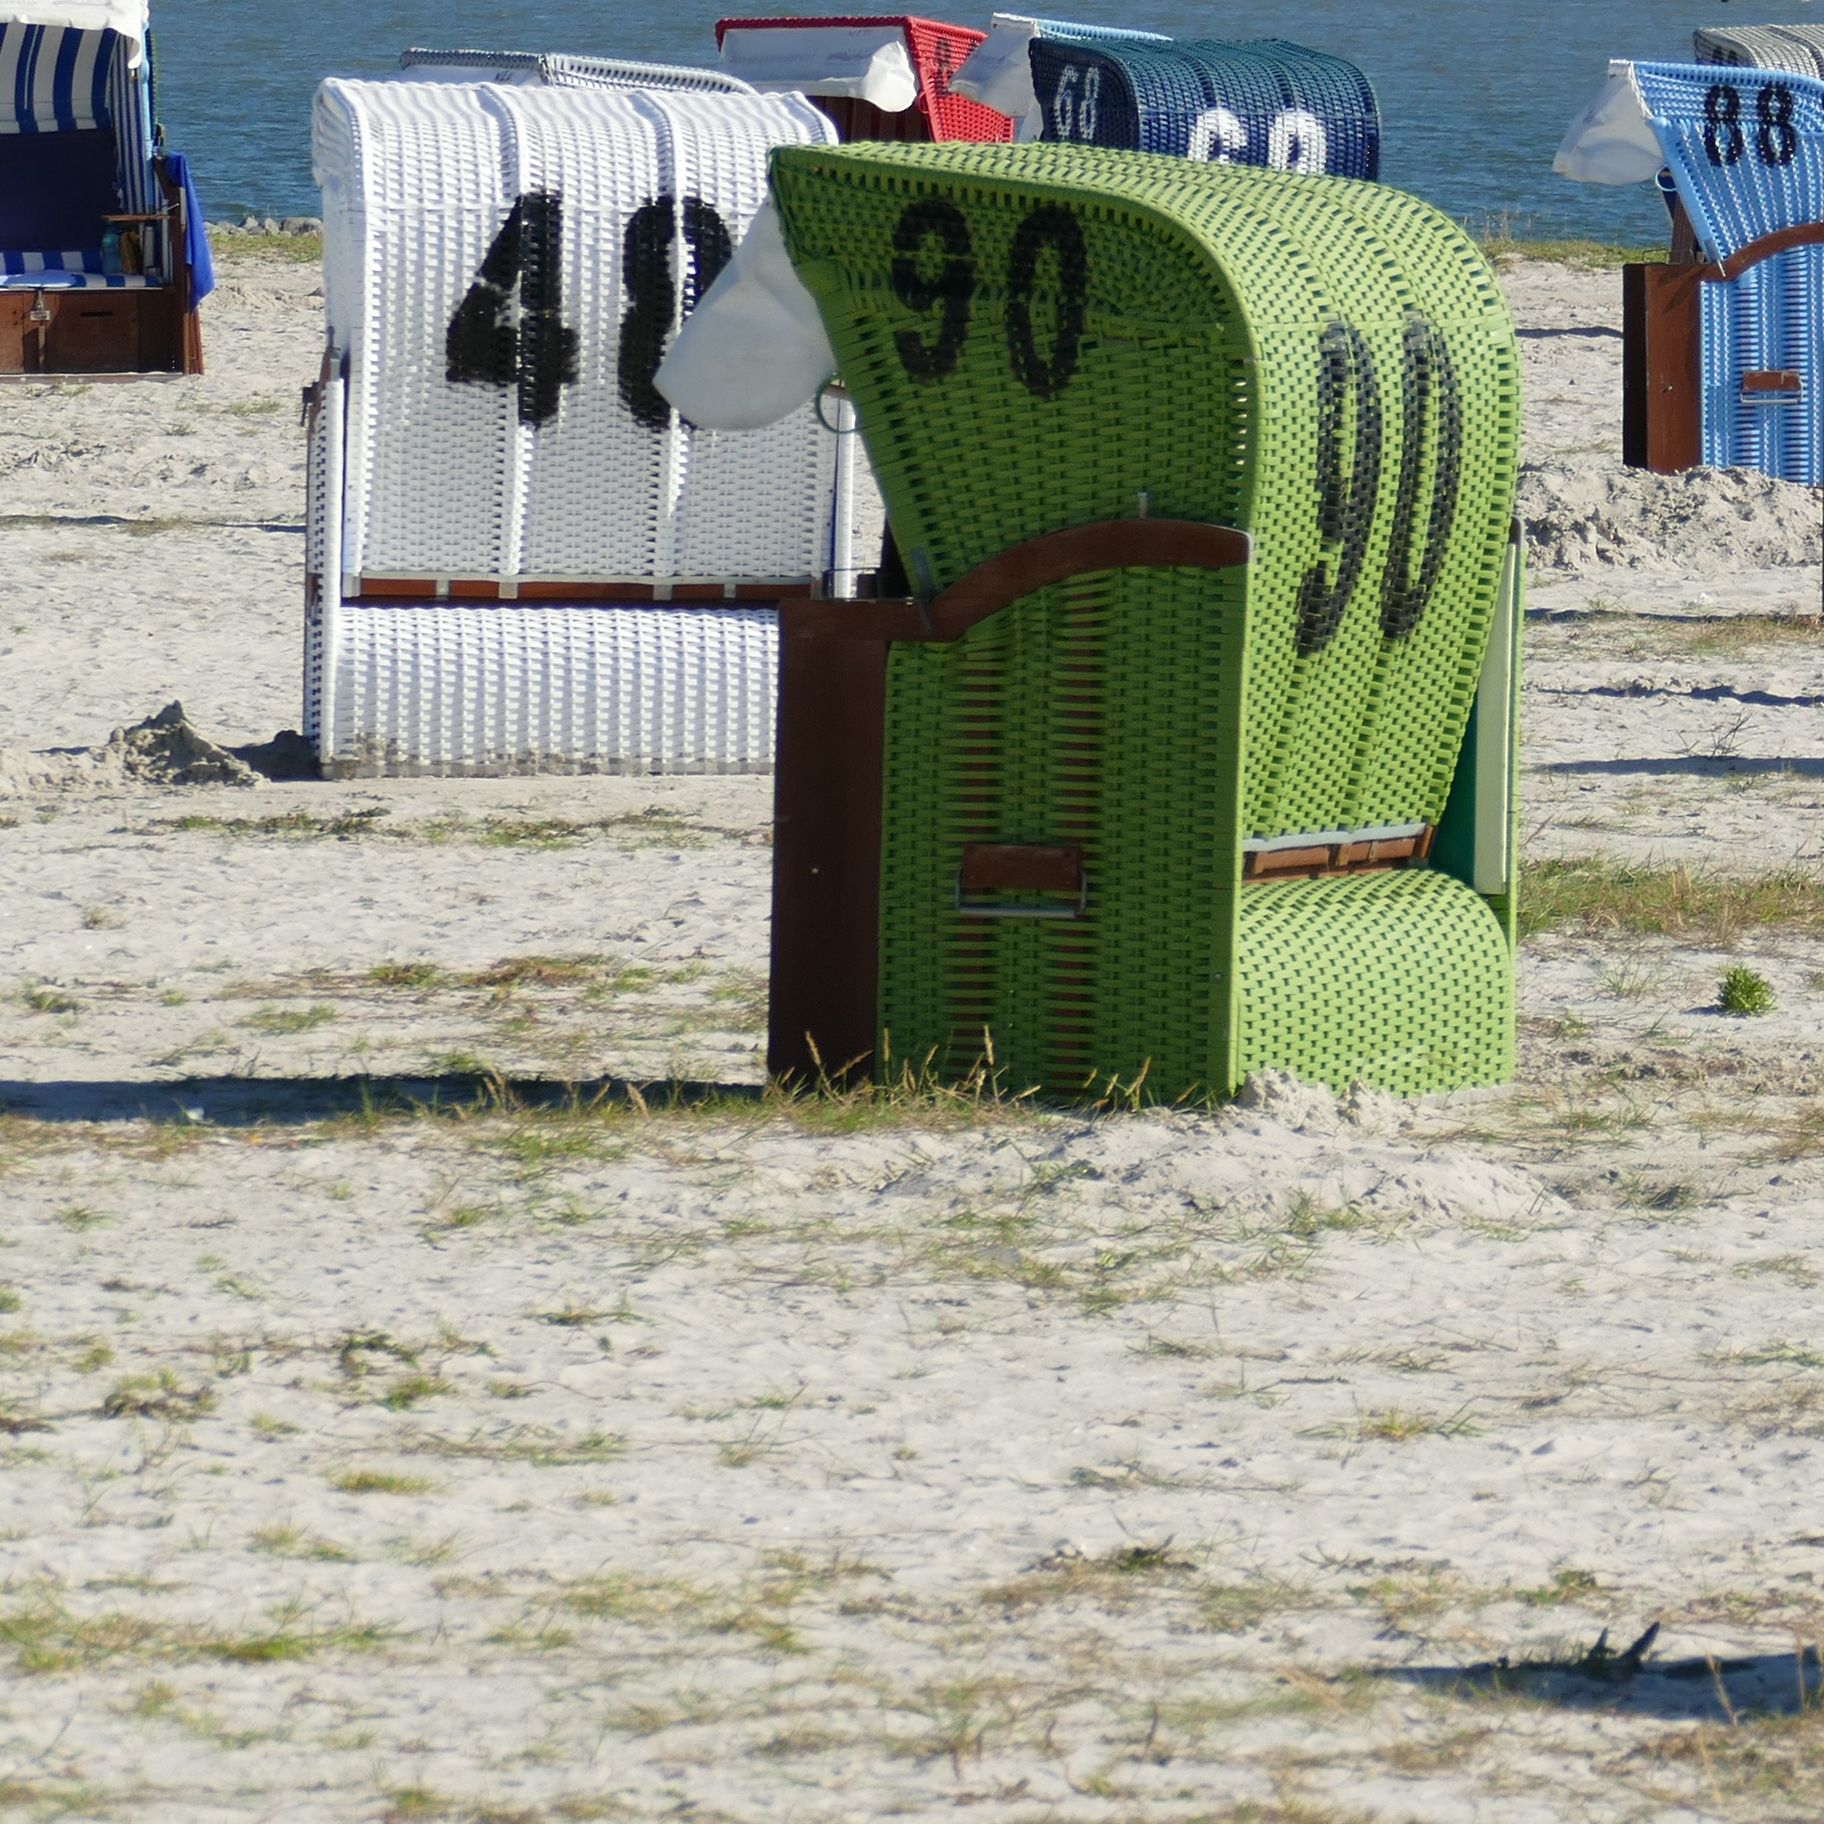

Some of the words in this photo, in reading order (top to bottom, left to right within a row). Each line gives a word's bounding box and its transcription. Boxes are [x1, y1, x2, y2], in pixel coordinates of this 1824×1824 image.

[1054, 64, 1100, 140] 68
[1704, 83, 1795, 167] 88
[892, 198, 1087, 400] 90
[1298, 318, 1463, 658] 90
